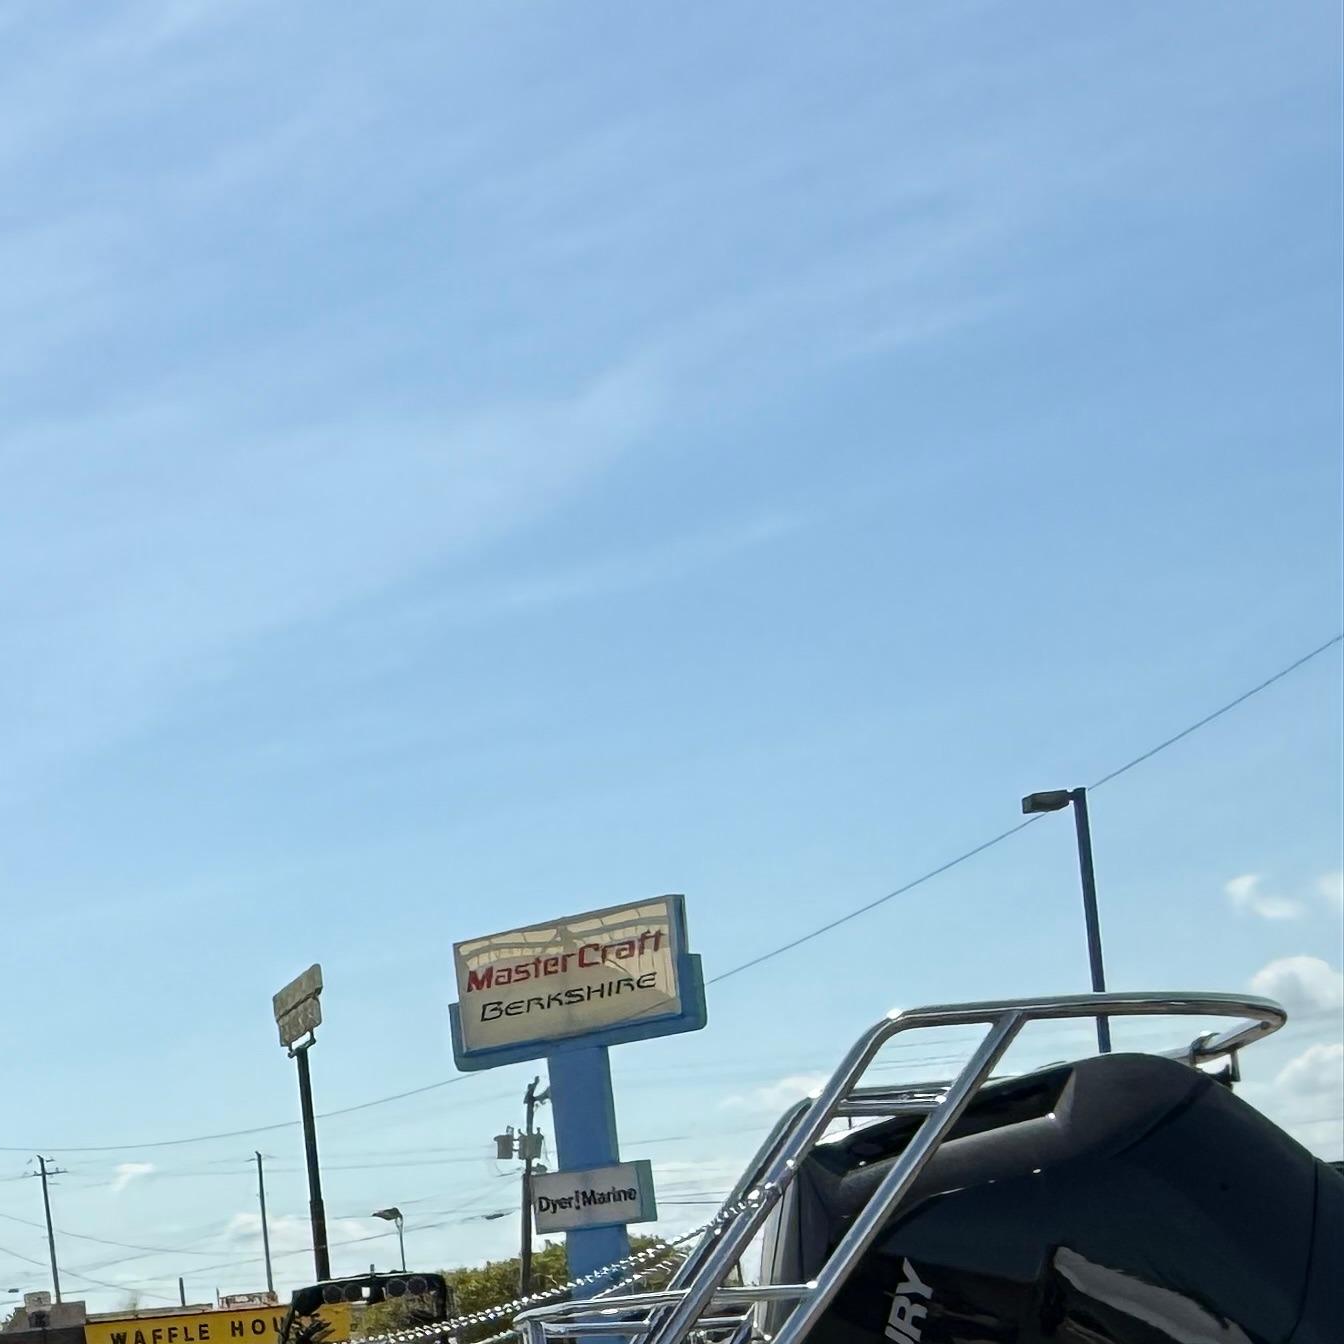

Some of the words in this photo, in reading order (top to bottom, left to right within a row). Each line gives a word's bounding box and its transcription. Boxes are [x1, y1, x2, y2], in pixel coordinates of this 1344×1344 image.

[466, 929, 665, 993] MasterCraft
[480, 972, 658, 1023] BERKSHIRE
[230, 1316, 286, 1338] HOU
